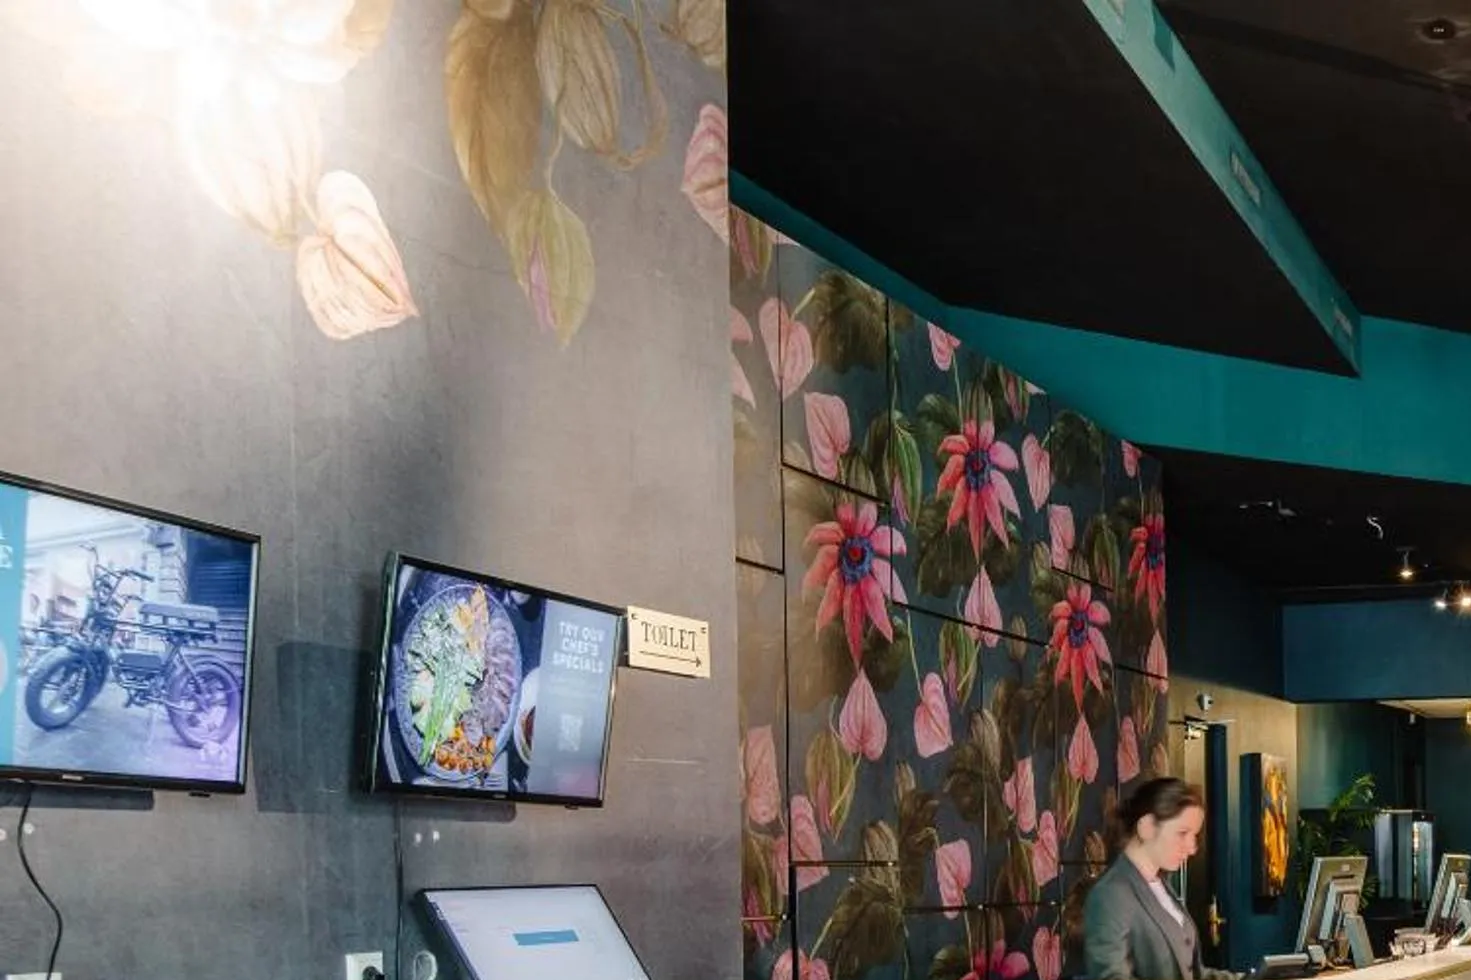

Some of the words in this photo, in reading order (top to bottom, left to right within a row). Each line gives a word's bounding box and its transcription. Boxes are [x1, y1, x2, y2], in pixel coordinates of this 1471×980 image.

[559, 620, 578, 637] TRY
[641, 620, 697, 651] TOILET
[552, 651, 604, 673] SPECIALS
